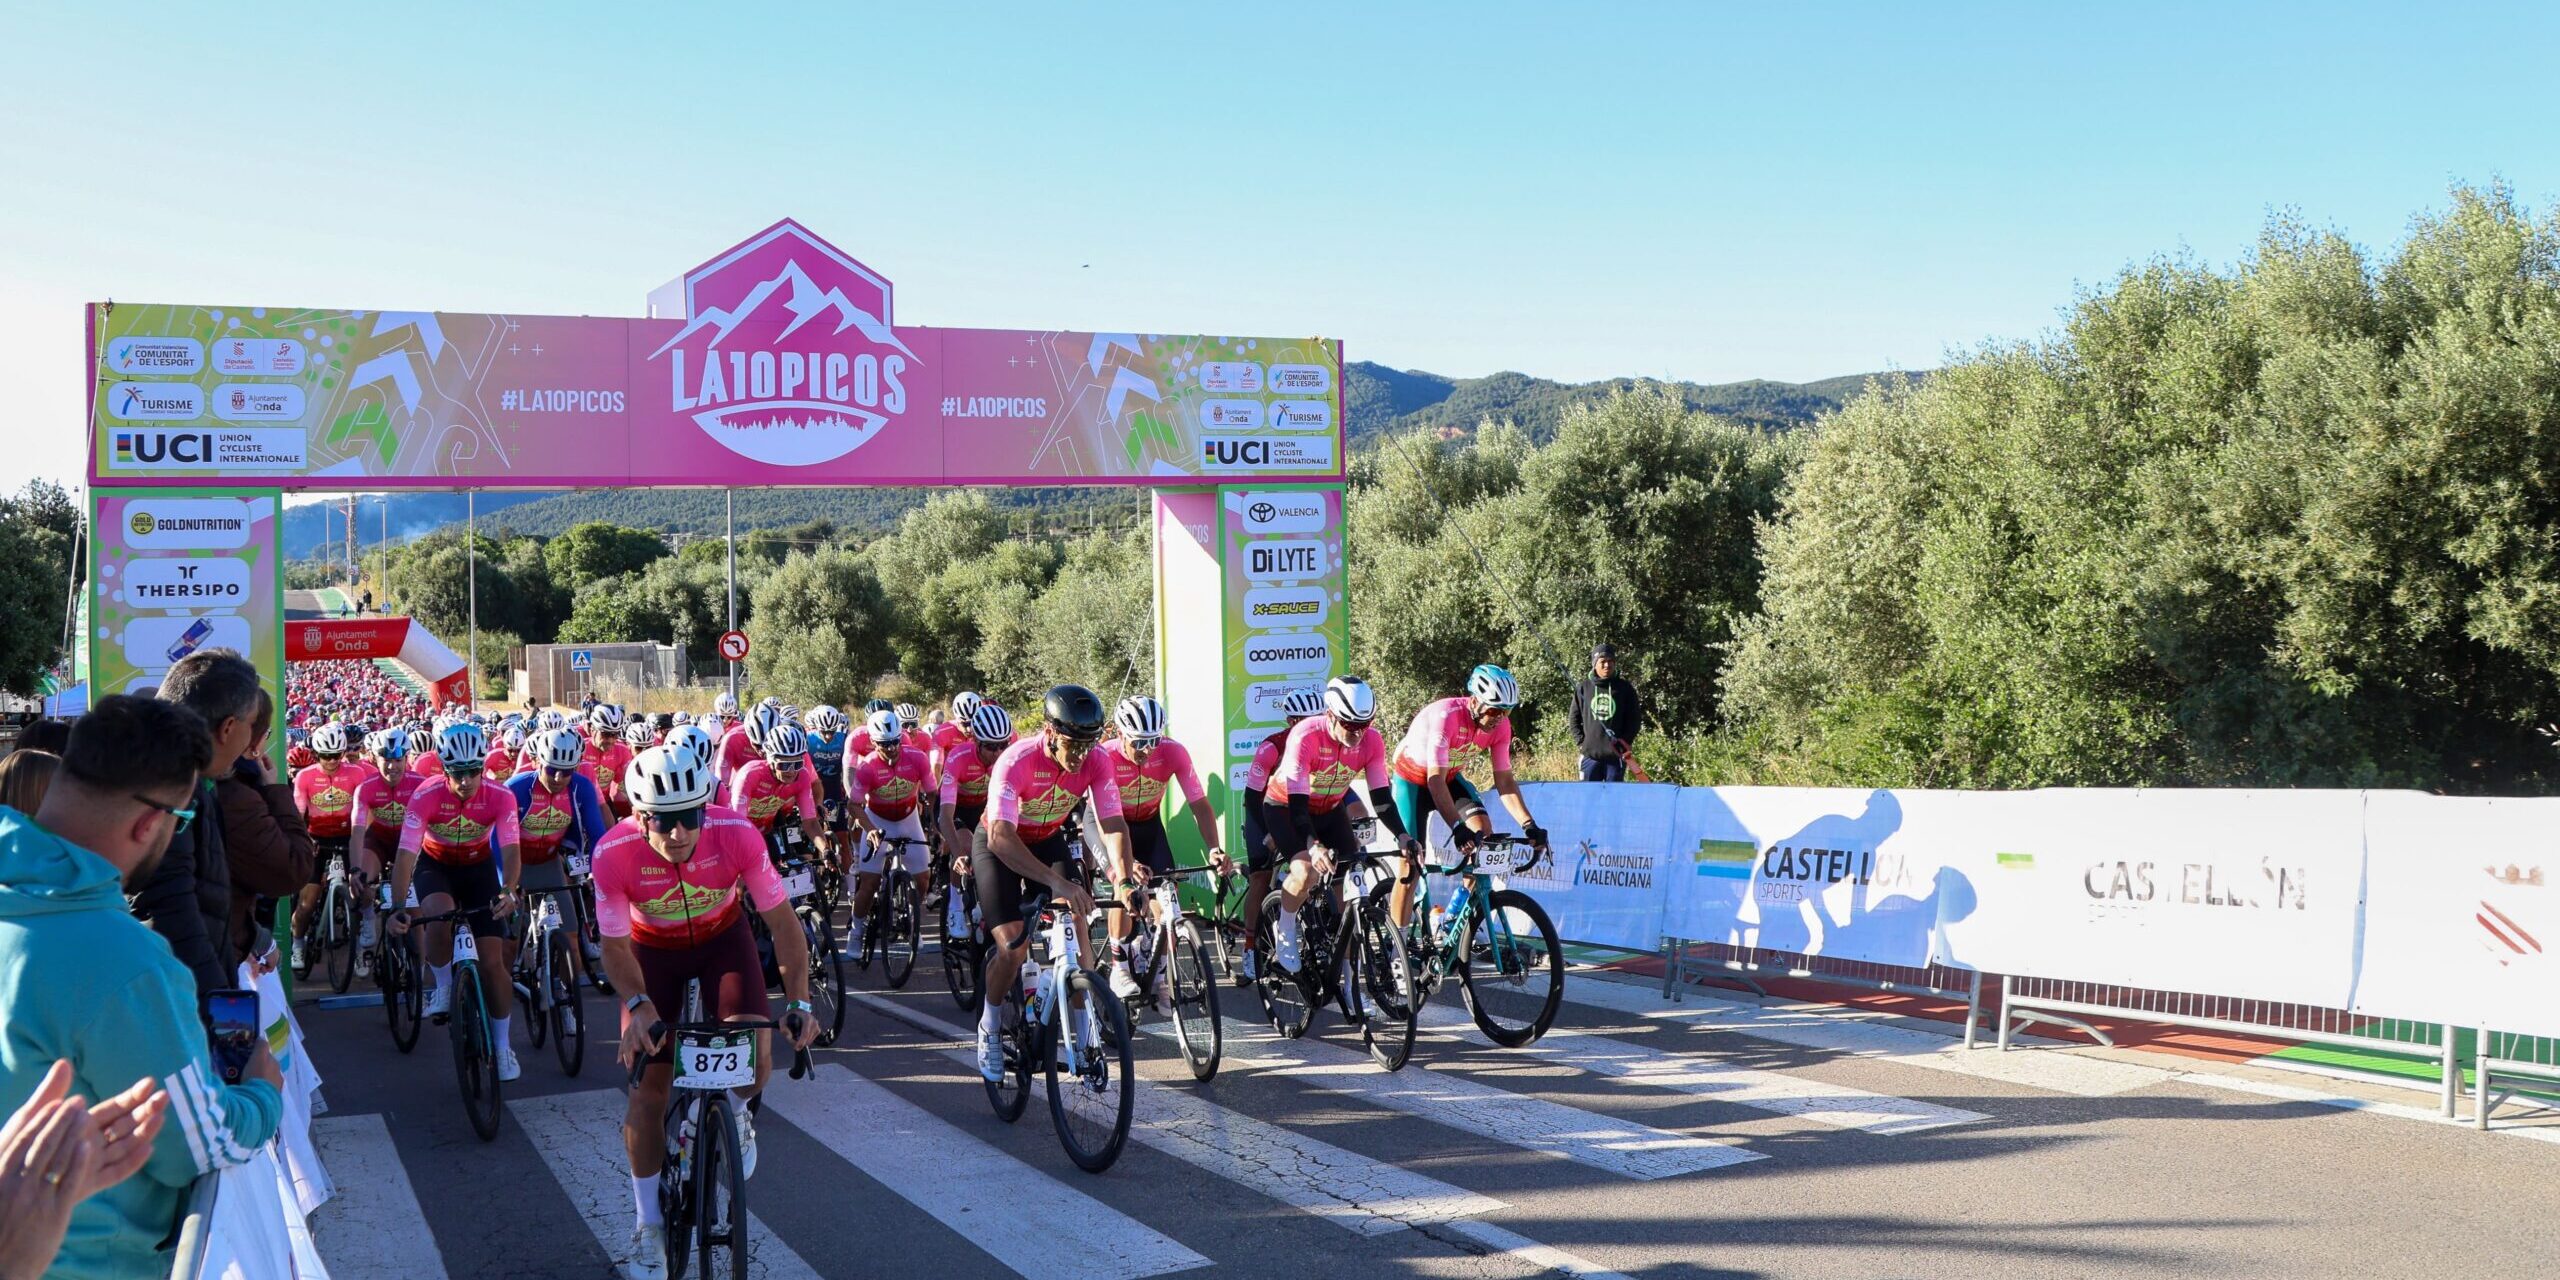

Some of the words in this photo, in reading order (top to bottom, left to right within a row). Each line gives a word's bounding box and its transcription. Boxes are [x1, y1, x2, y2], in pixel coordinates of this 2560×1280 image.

[135, 350, 189, 358] COMUNITAT
[139, 358, 151, 366] DE
[153, 358, 195, 367] L'ESPORT
[672, 348, 906, 416] LA10PICOS
[1296, 380, 1323, 388] L'ESPORT
[141, 399, 193, 410] TURISME
[248, 394, 288, 402] Ajuntament
[501, 390, 625, 414] #LA10PICOS
[254, 402, 282, 411] Onda
[940, 396, 1047, 418] #LA10PICOS
[1289, 413, 1323, 422] TURISME
[219, 434, 252, 442] UNION
[135, 433, 212, 463] UCI
[219, 444, 262, 452] CYCLISTE
[1217, 441, 1270, 465] UCI
[219, 454, 300, 463] INTERNATIONALE
[1273, 457, 1328, 465] INTERNATIONALE
[1278, 507, 1320, 517] VALENCIA
[157, 518, 241, 531] GOLDNUTRITION
[1252, 548, 1273, 573] Di
[1278, 547, 1316, 572] LYTE
[136, 583, 240, 597] THERSIPO
[1253, 601, 1320, 616] X-SAUCE
[326, 630, 377, 640] Ajuntament
[334, 639, 370, 651] Onda
[1485, 853, 1506, 866] 992
[1598, 853, 1654, 871] COMUNITAT
[1583, 869, 1652, 889] VALENCIANA
[1761, 882, 1804, 901] SPORTS
[456, 936, 473, 950] 10
[695, 1052, 738, 1073] 873
